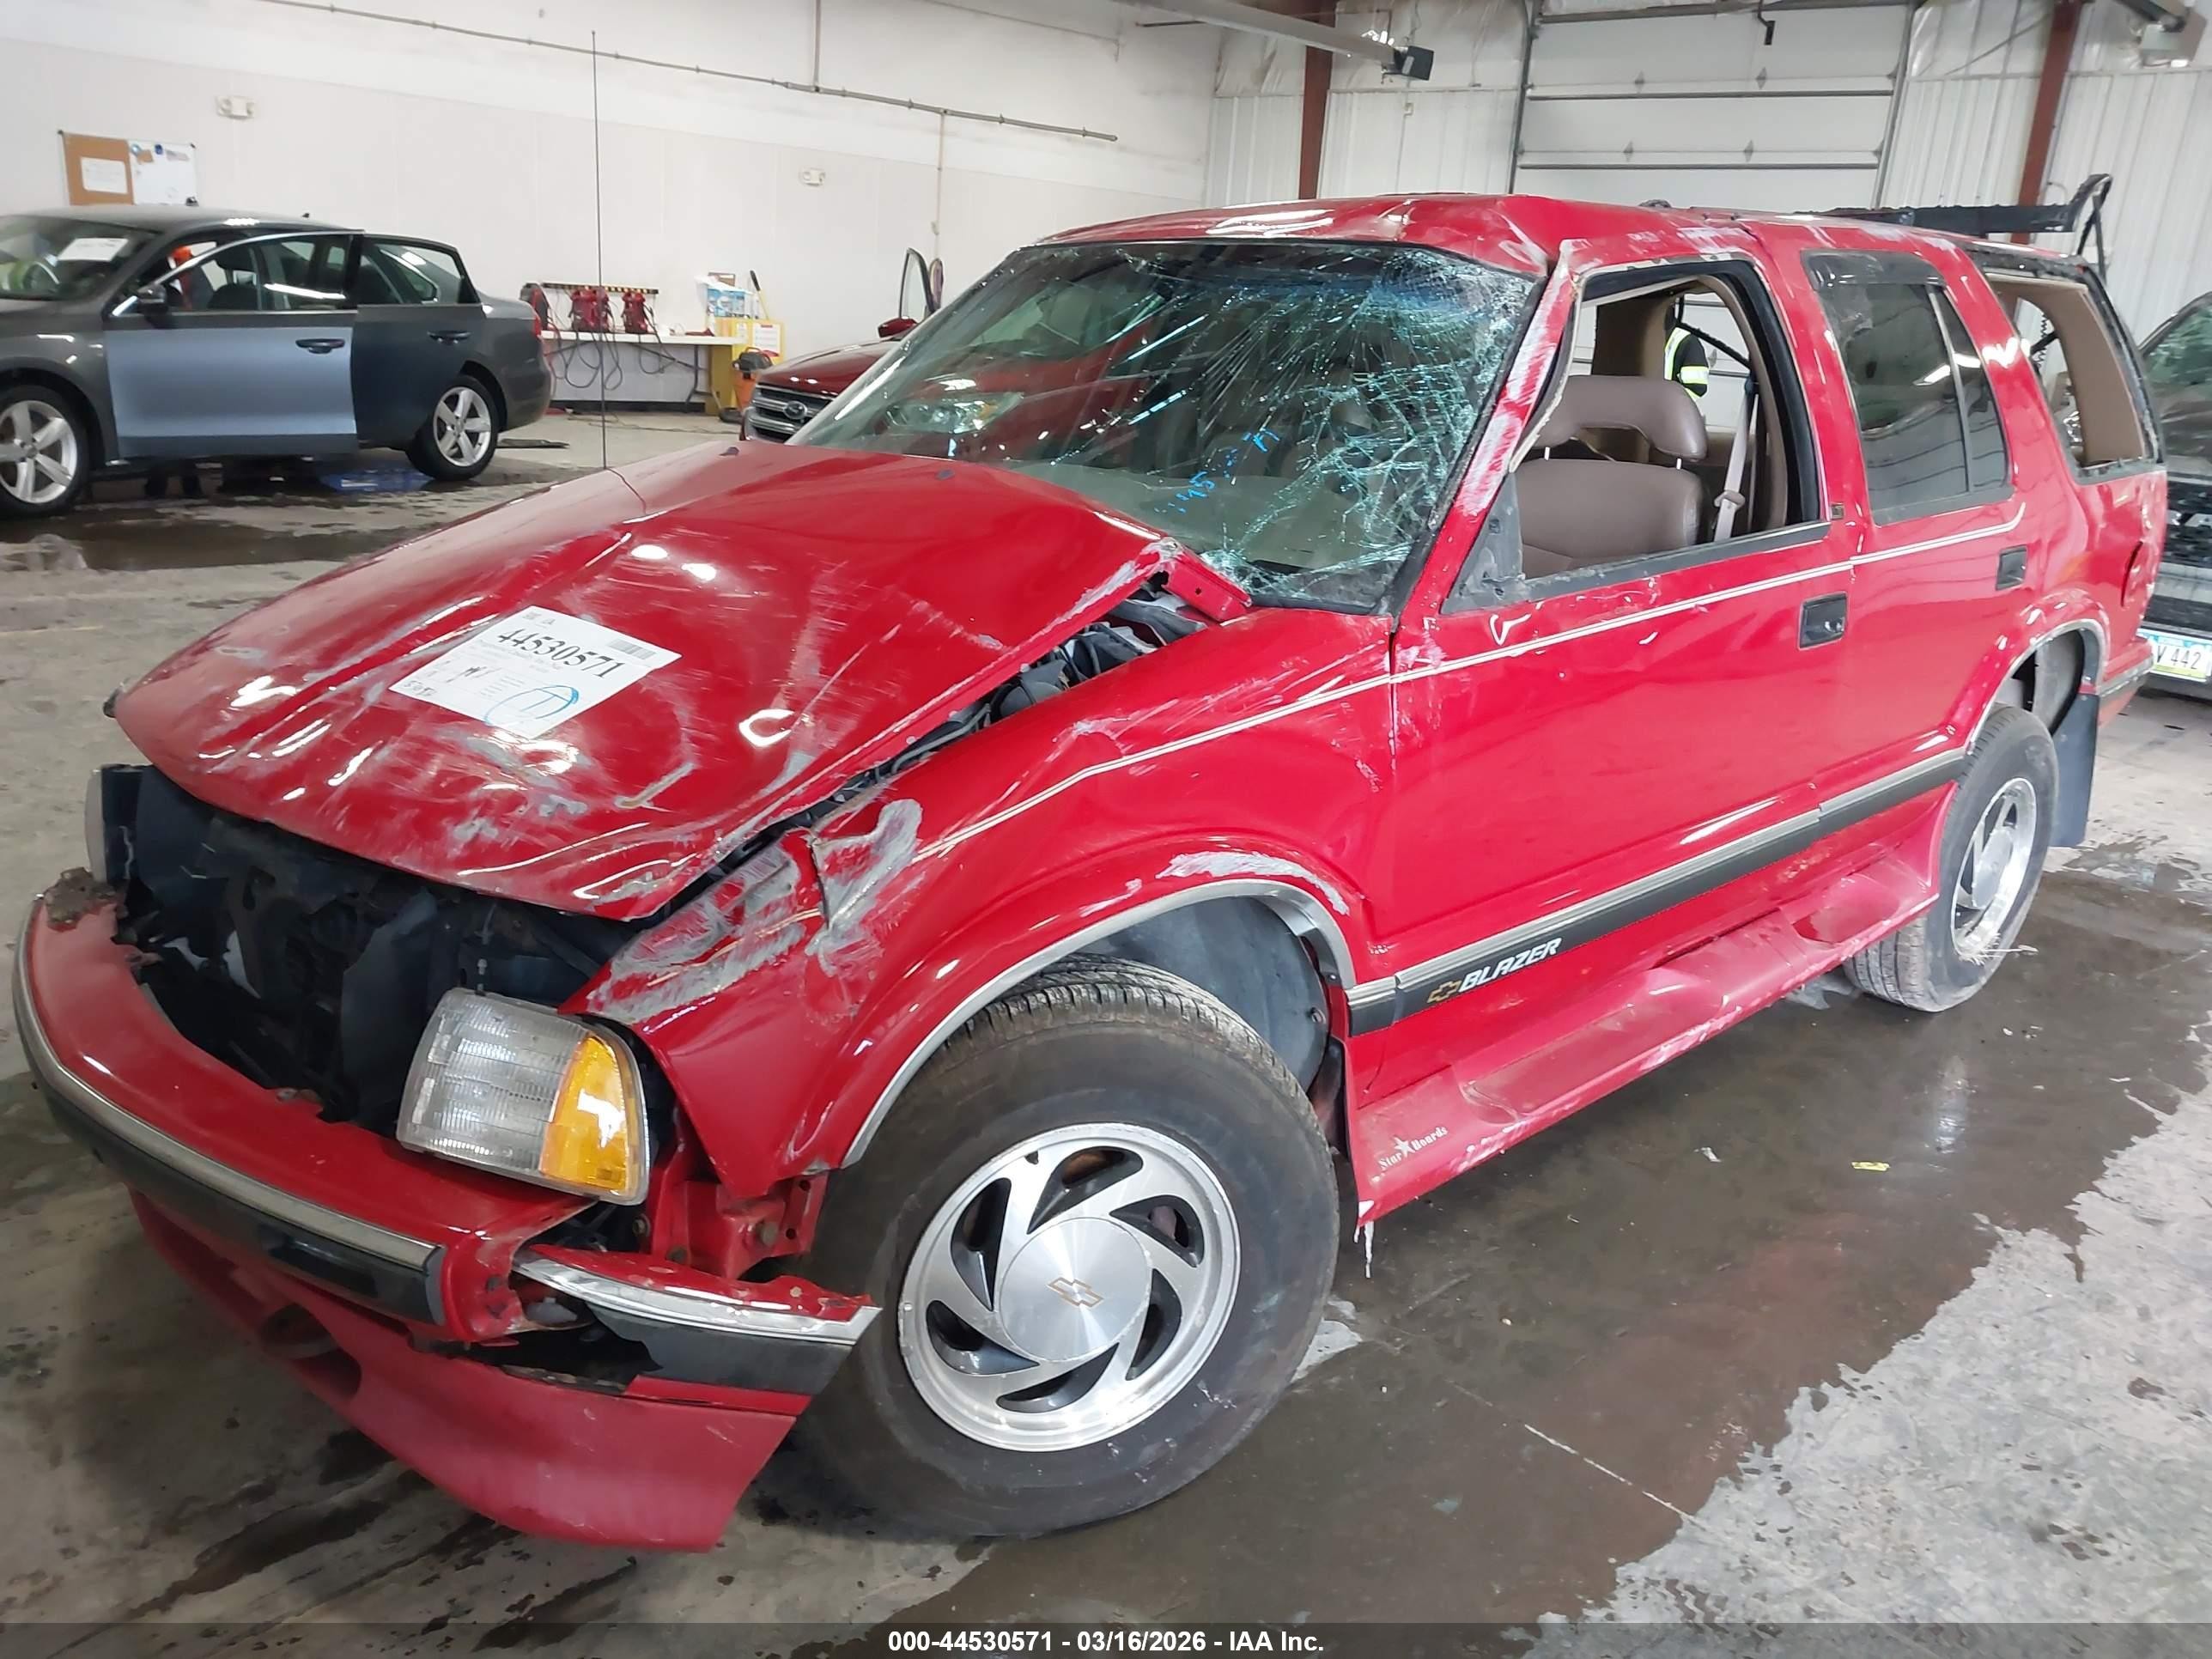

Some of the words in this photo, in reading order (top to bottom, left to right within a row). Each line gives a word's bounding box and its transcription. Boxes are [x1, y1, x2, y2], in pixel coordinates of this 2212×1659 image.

[497, 628, 626, 678] 44530571
[2171, 648, 2203, 670] 442
[1459, 937, 1563, 993] BLAZER
